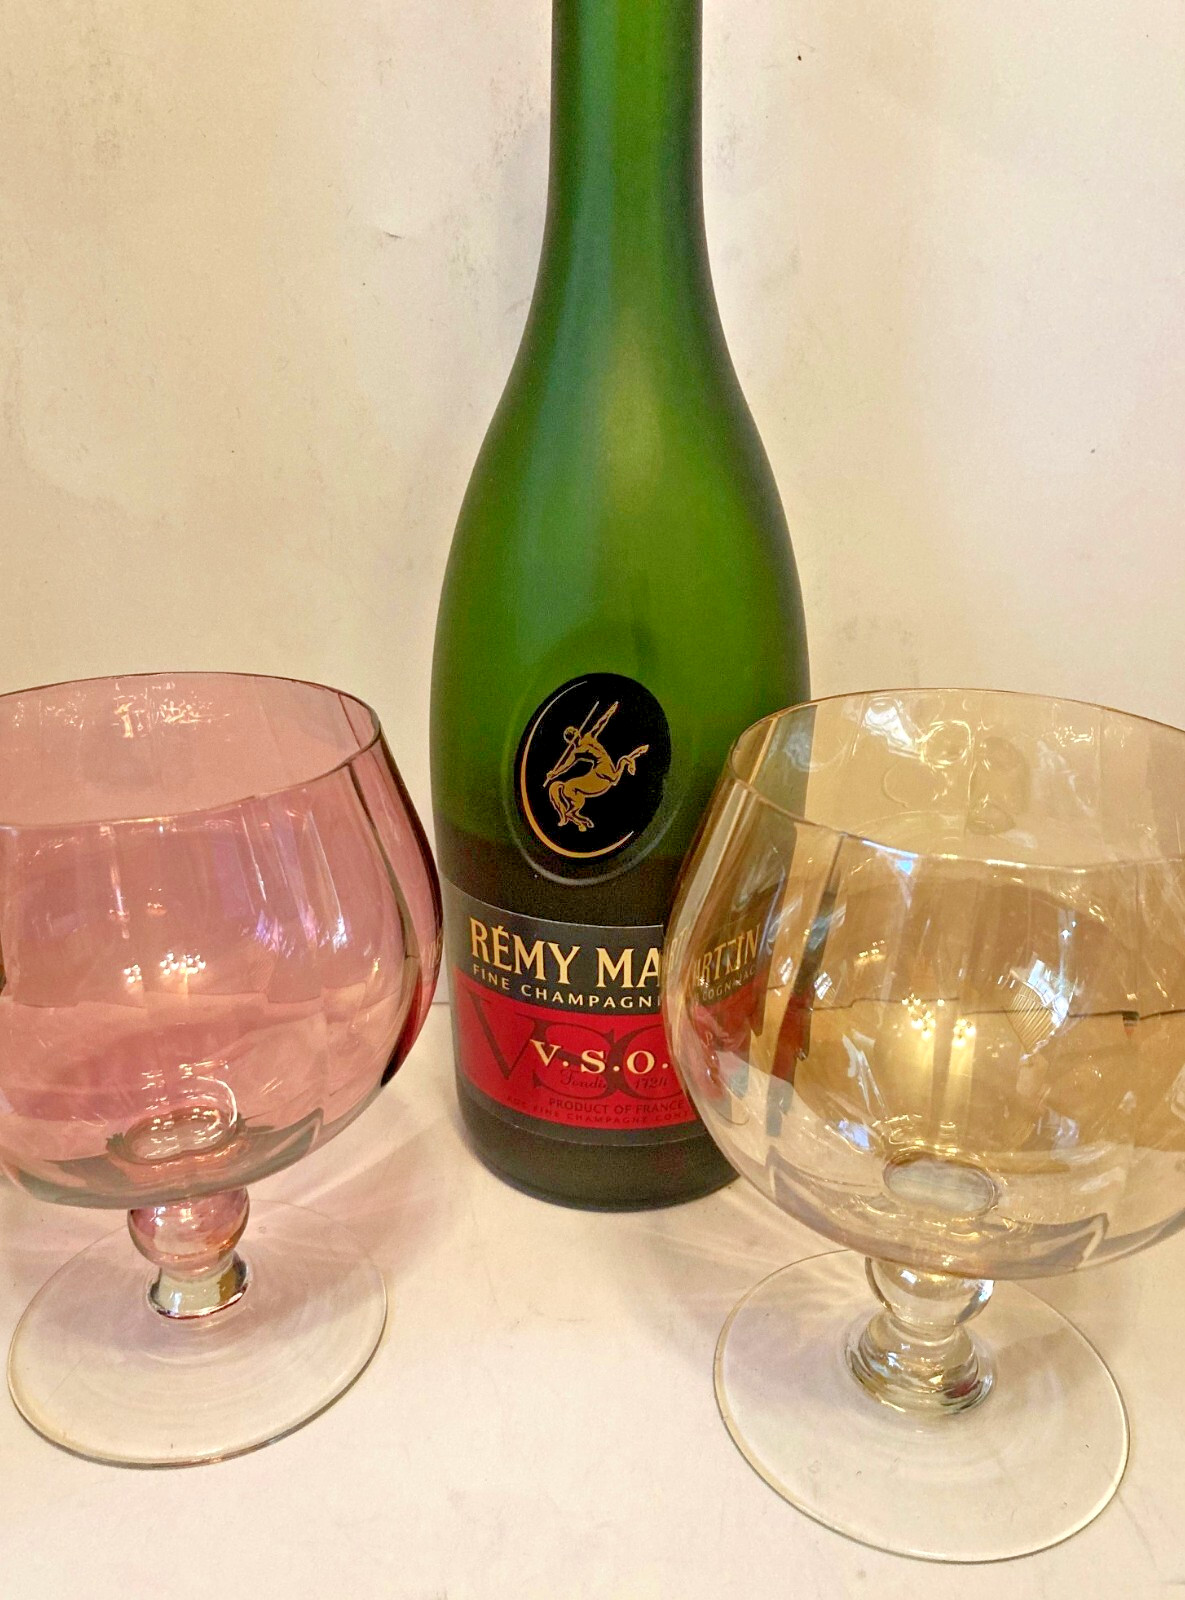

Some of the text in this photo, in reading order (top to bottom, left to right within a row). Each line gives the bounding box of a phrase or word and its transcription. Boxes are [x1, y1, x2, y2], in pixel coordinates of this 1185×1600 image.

[470, 917, 581, 985] RÉMY
[473, 963, 512, 990] FINE
[548, 1097, 684, 1115] PRODUCT OF FRANCE
